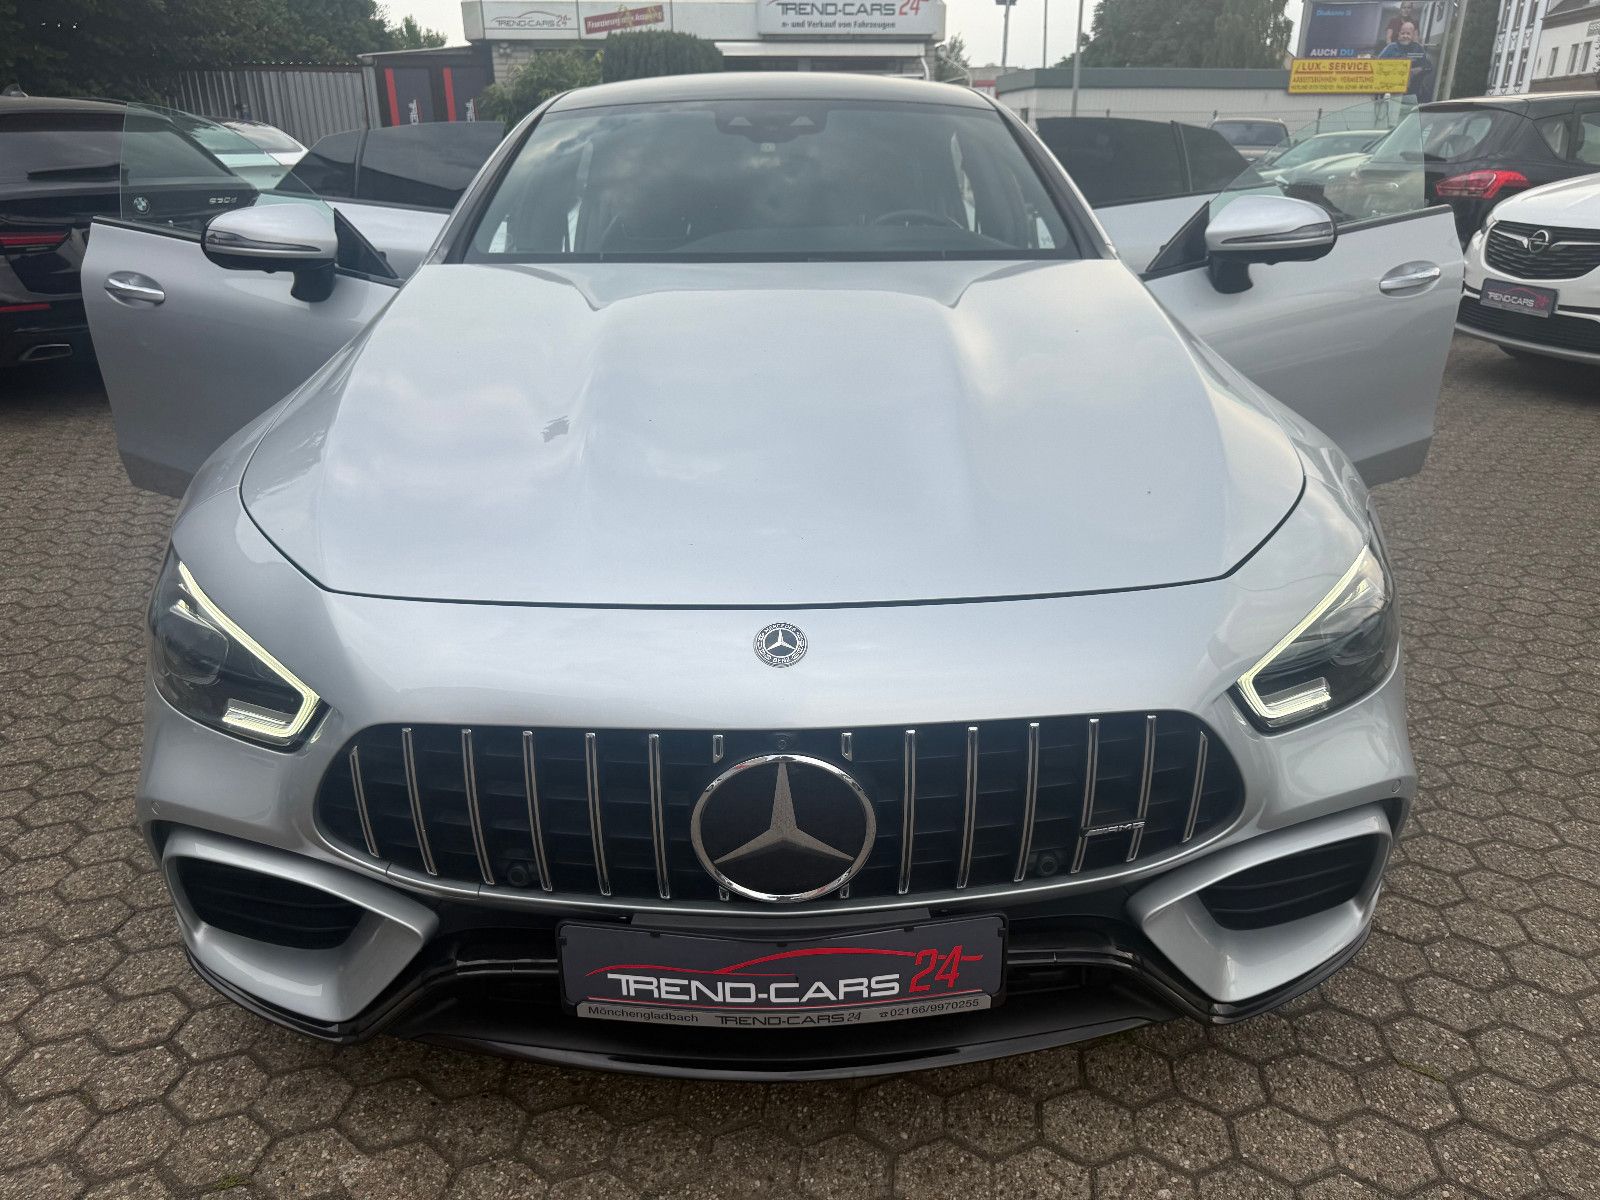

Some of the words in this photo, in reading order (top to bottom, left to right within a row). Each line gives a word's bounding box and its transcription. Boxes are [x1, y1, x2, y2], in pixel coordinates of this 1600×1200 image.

[777, 3, 896, 16] TREND-CARS
[898, 0, 924, 16] 24
[791, 20, 806, 28] und
[807, 20, 837, 28] Verkauf
[853, 20, 896, 30] Fahrzeugen
[1310, 48, 1338, 57] AUCH
[1340, 48, 1355, 56] DU
[1328, 62, 1369, 71] SERVICE
[607, 973, 900, 1003] TREND-CARS
[908, 944, 974, 993] 24
[588, 1005, 699, 1023] Mönchengladbach
[715, 1012, 845, 1027] TREND-CARS
[846, 1012, 862, 1022] 24
[889, 998, 980, 1018] 02166/9970255
